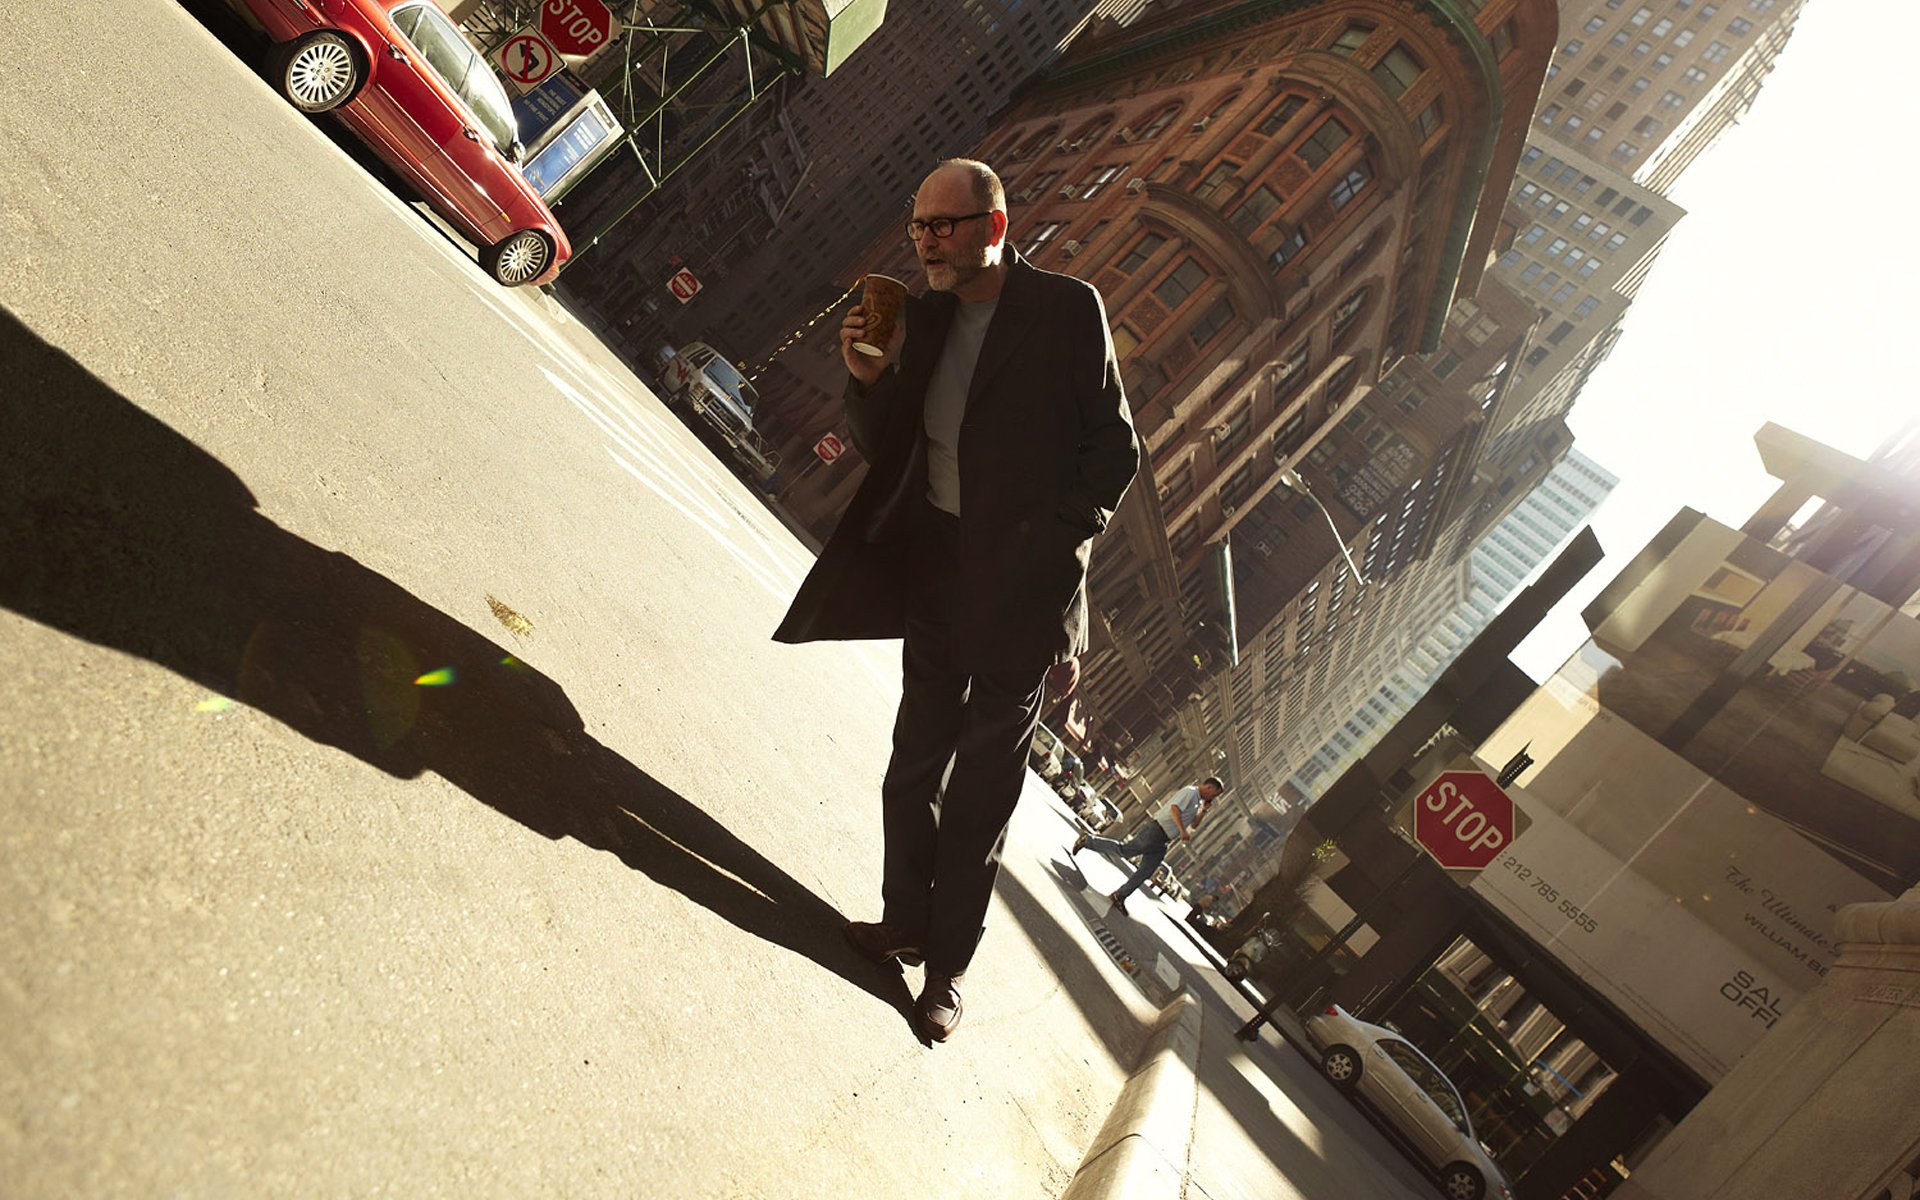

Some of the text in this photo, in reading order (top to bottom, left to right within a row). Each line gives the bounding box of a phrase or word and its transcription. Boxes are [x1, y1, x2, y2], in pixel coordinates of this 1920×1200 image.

[549, 0, 602, 44] STOP
[1426, 781, 1504, 852] STOP
[1503, 856, 1598, 934] 212 785 5555
[1725, 865, 1828, 947] The Ultimate
[1744, 912, 1808, 962] WILLIAM
[1719, 982, 1778, 1030] OFFI
[1733, 970, 1782, 1017] SAL
